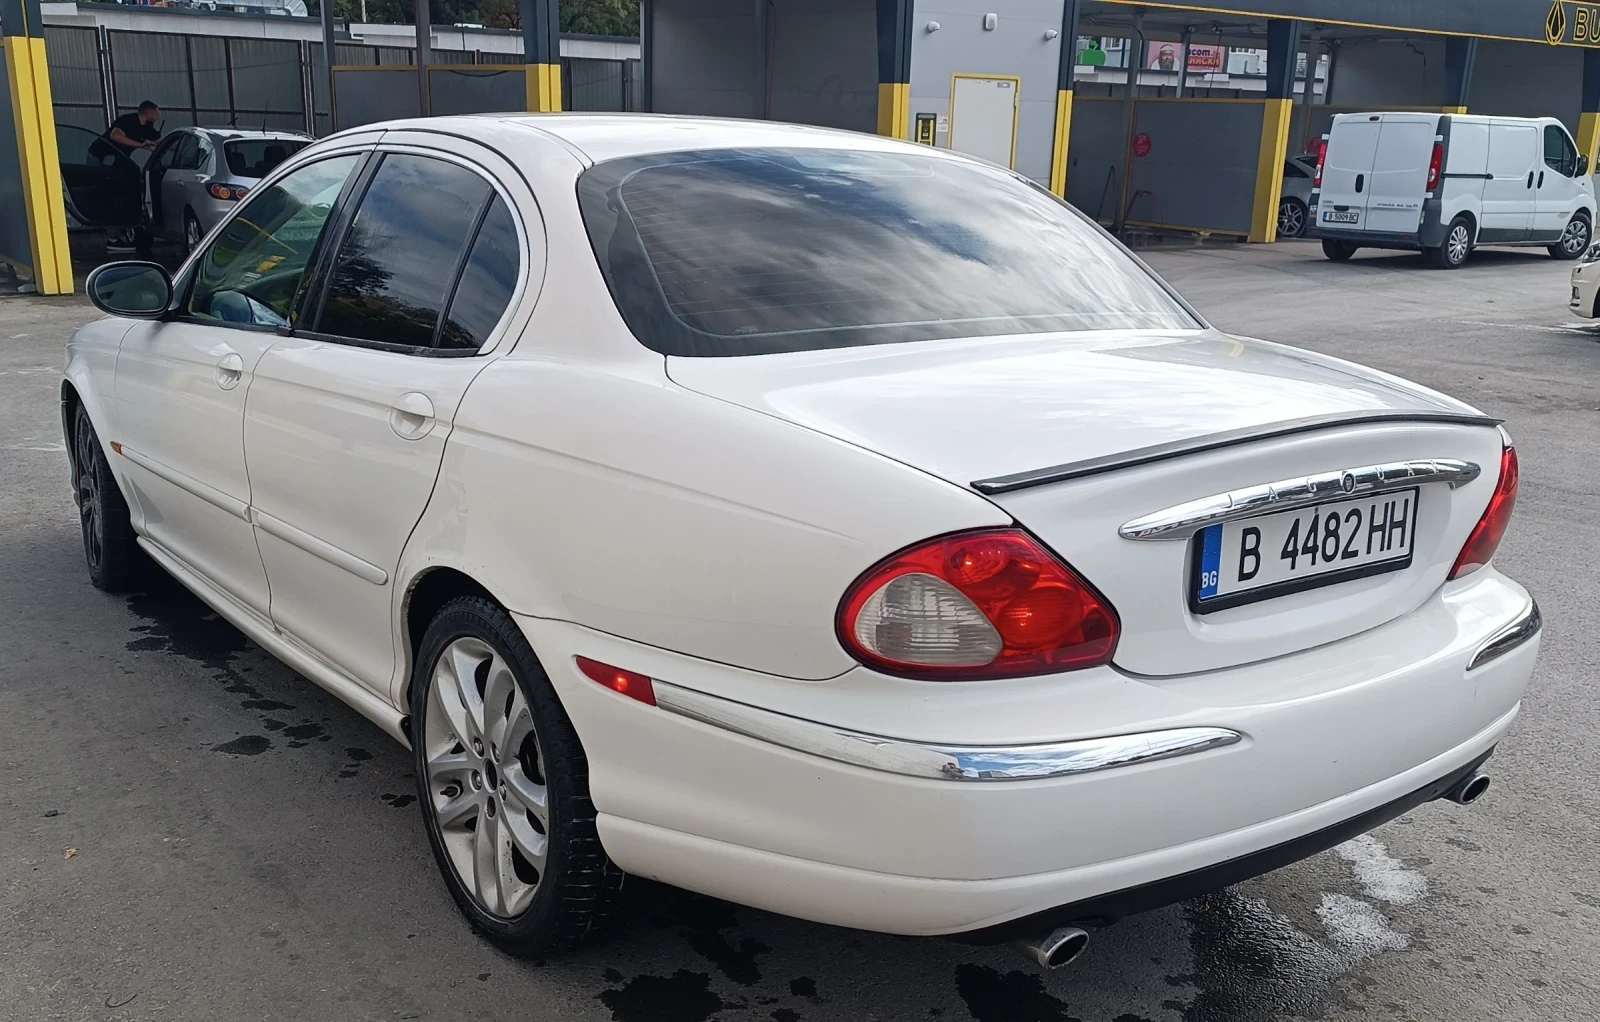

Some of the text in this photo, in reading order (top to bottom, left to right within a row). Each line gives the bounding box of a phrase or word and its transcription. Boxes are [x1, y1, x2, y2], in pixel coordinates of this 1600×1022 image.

[1188, 49, 1213, 57] com.
[1226, 459, 1439, 509] JAGUAR
[1201, 571, 1218, 589] BG
